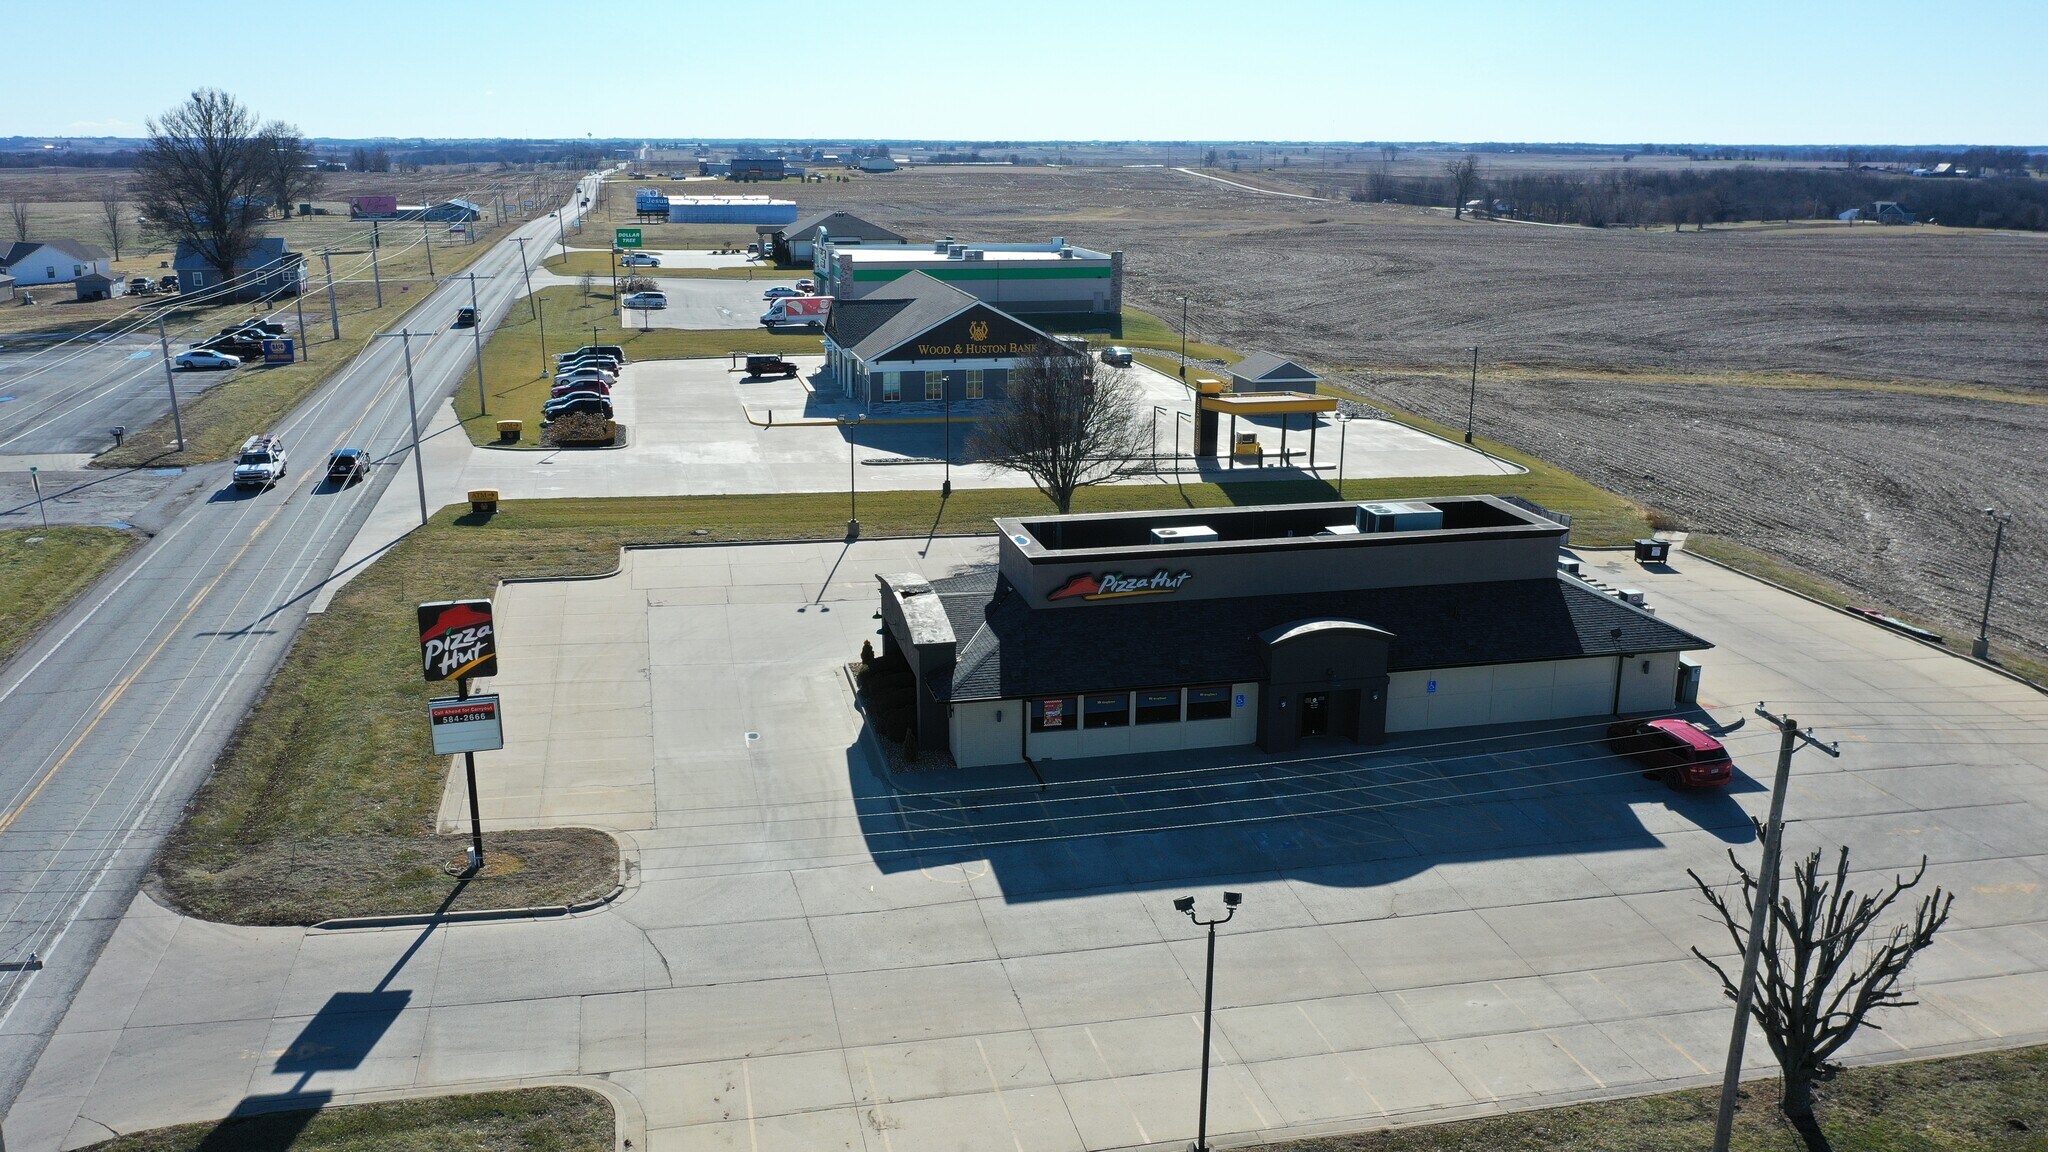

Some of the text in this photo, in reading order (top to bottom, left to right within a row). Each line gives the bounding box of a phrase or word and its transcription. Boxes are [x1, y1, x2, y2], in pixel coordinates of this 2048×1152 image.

[918, 342, 1038, 355] WOOD & HUSTON BANK
[1097, 571, 1192, 594] Pizza Hut
[425, 625, 493, 671] Pizza
[438, 641, 488, 676] Hut
[443, 713, 486, 723] 584-2666
